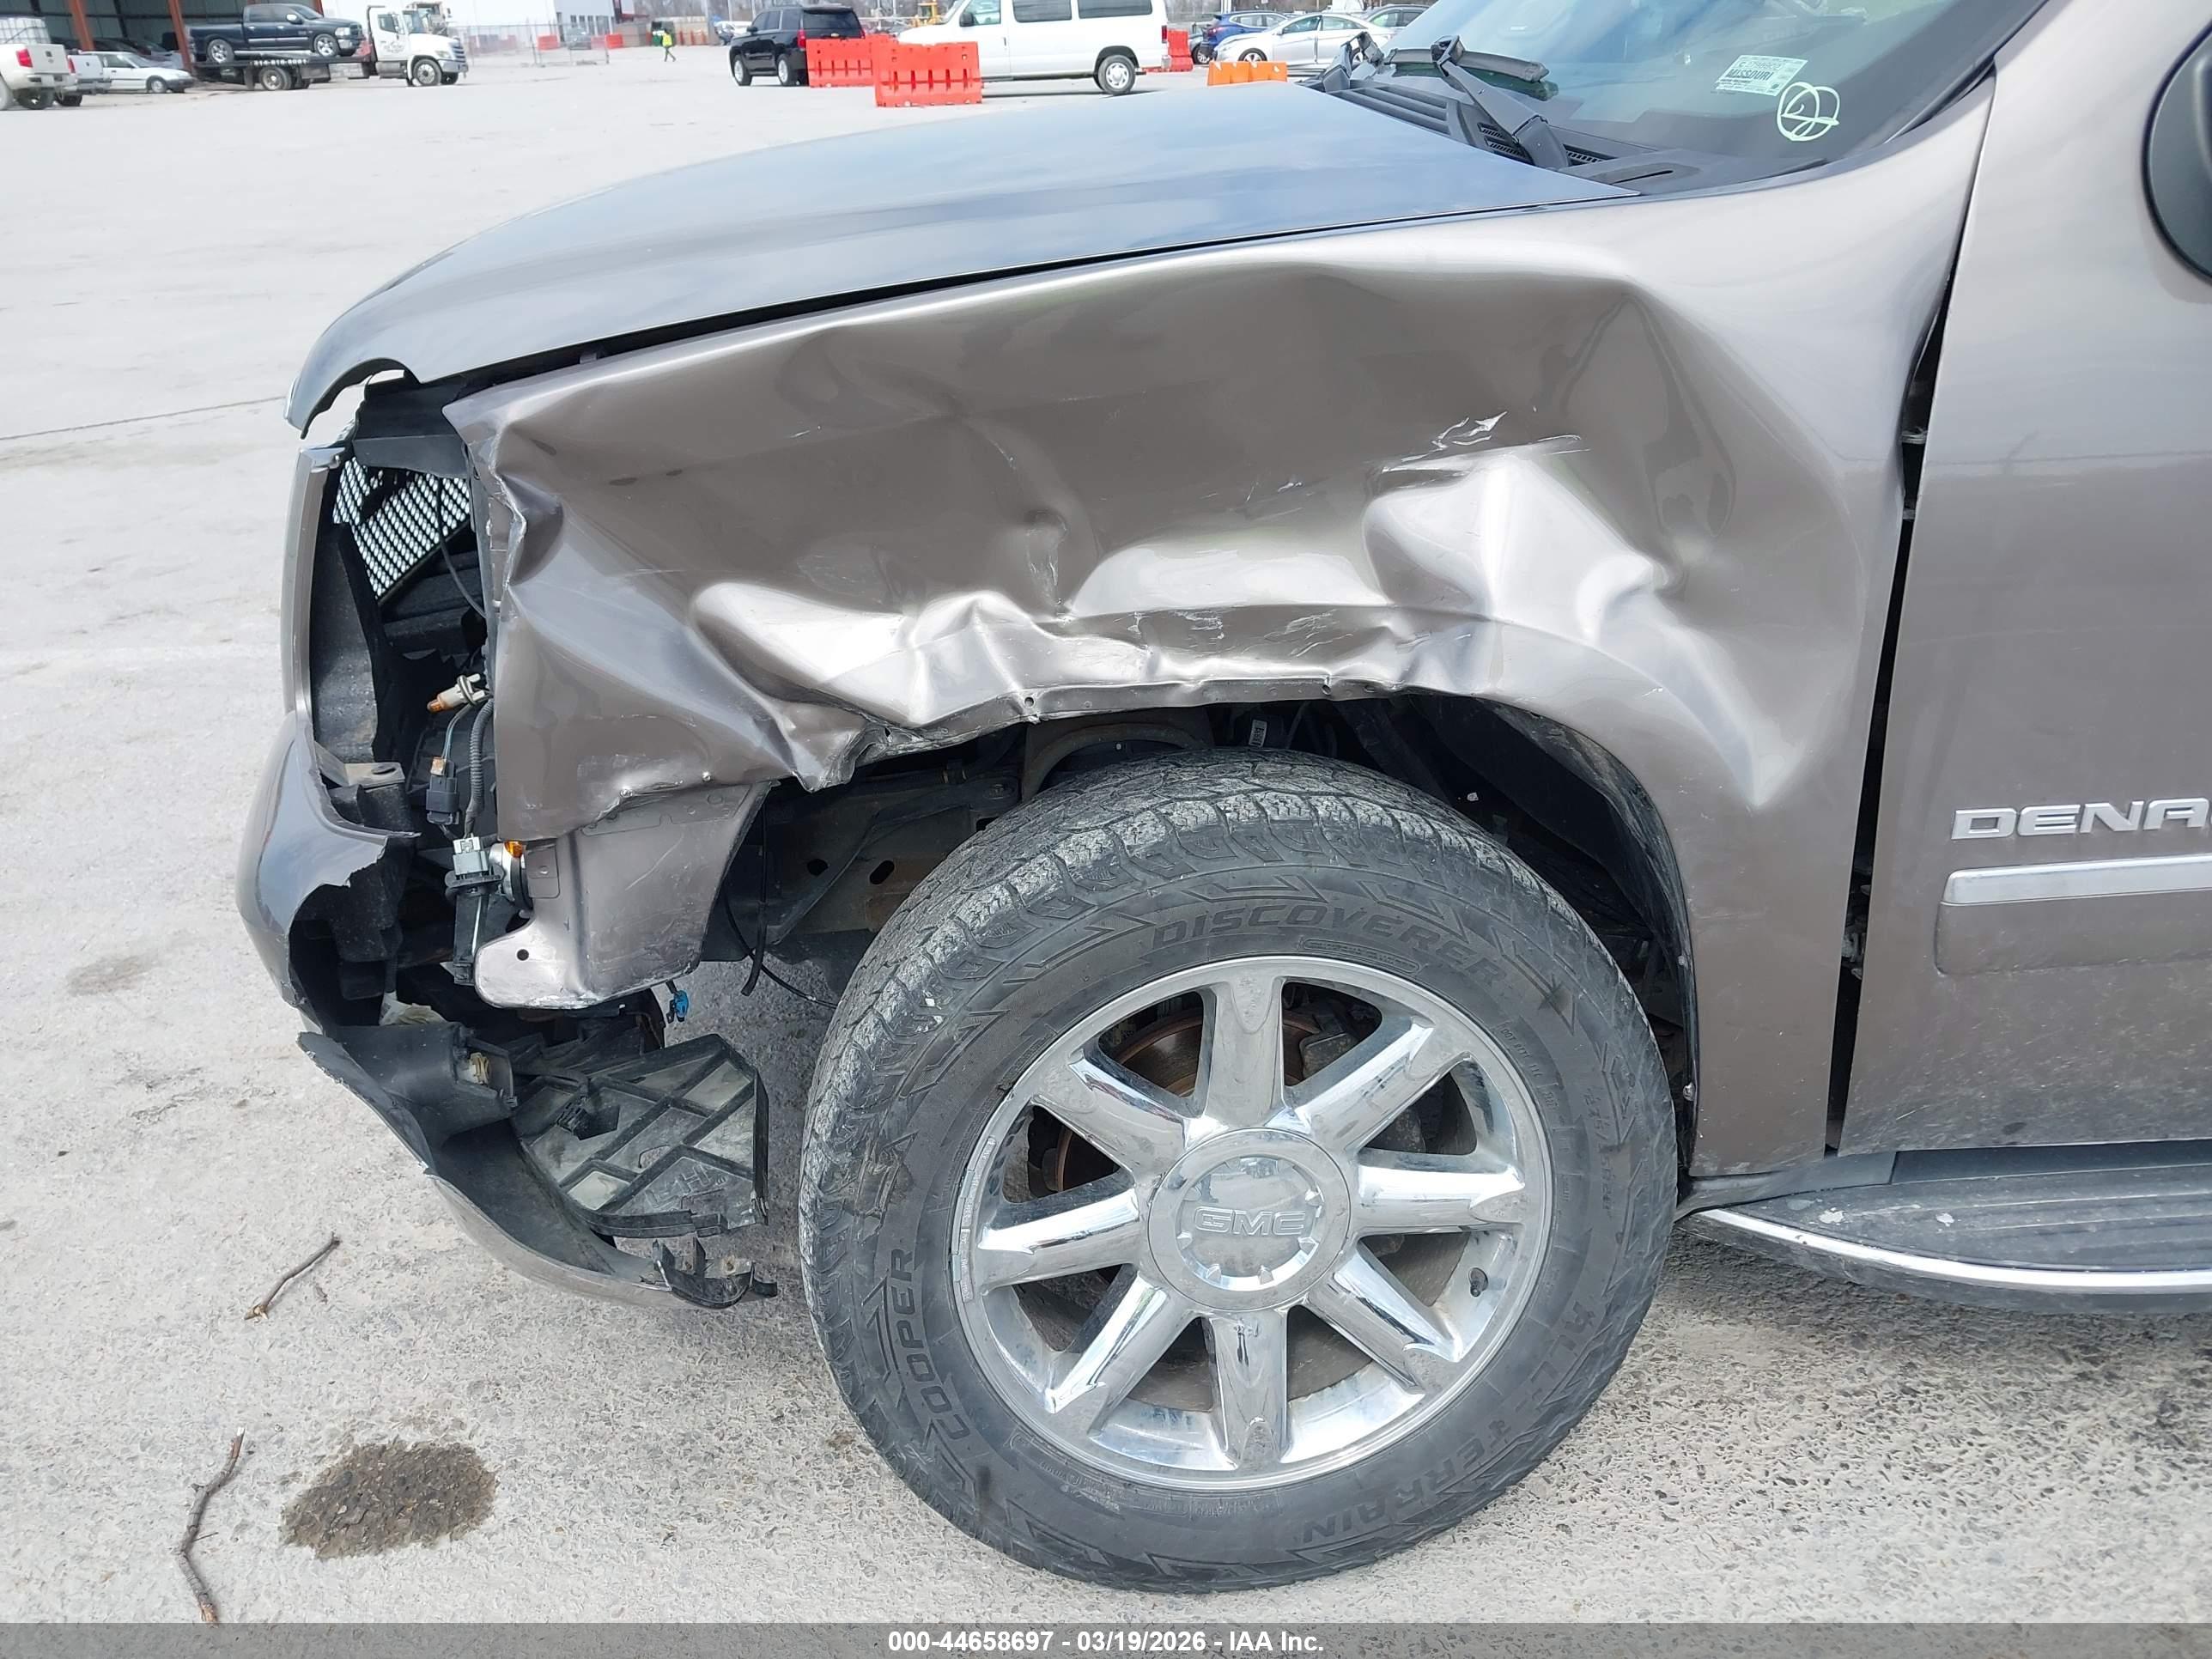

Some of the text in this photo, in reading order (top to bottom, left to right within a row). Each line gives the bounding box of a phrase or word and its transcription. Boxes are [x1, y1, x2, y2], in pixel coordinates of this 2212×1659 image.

[1725, 69, 1774, 81] MISSOURI
[1950, 797, 2212, 840] DENA
[1153, 905, 1509, 989] DISCOVERER
[1194, 1206, 1306, 1237] GMC
[890, 1249, 970, 1441] COOPER
